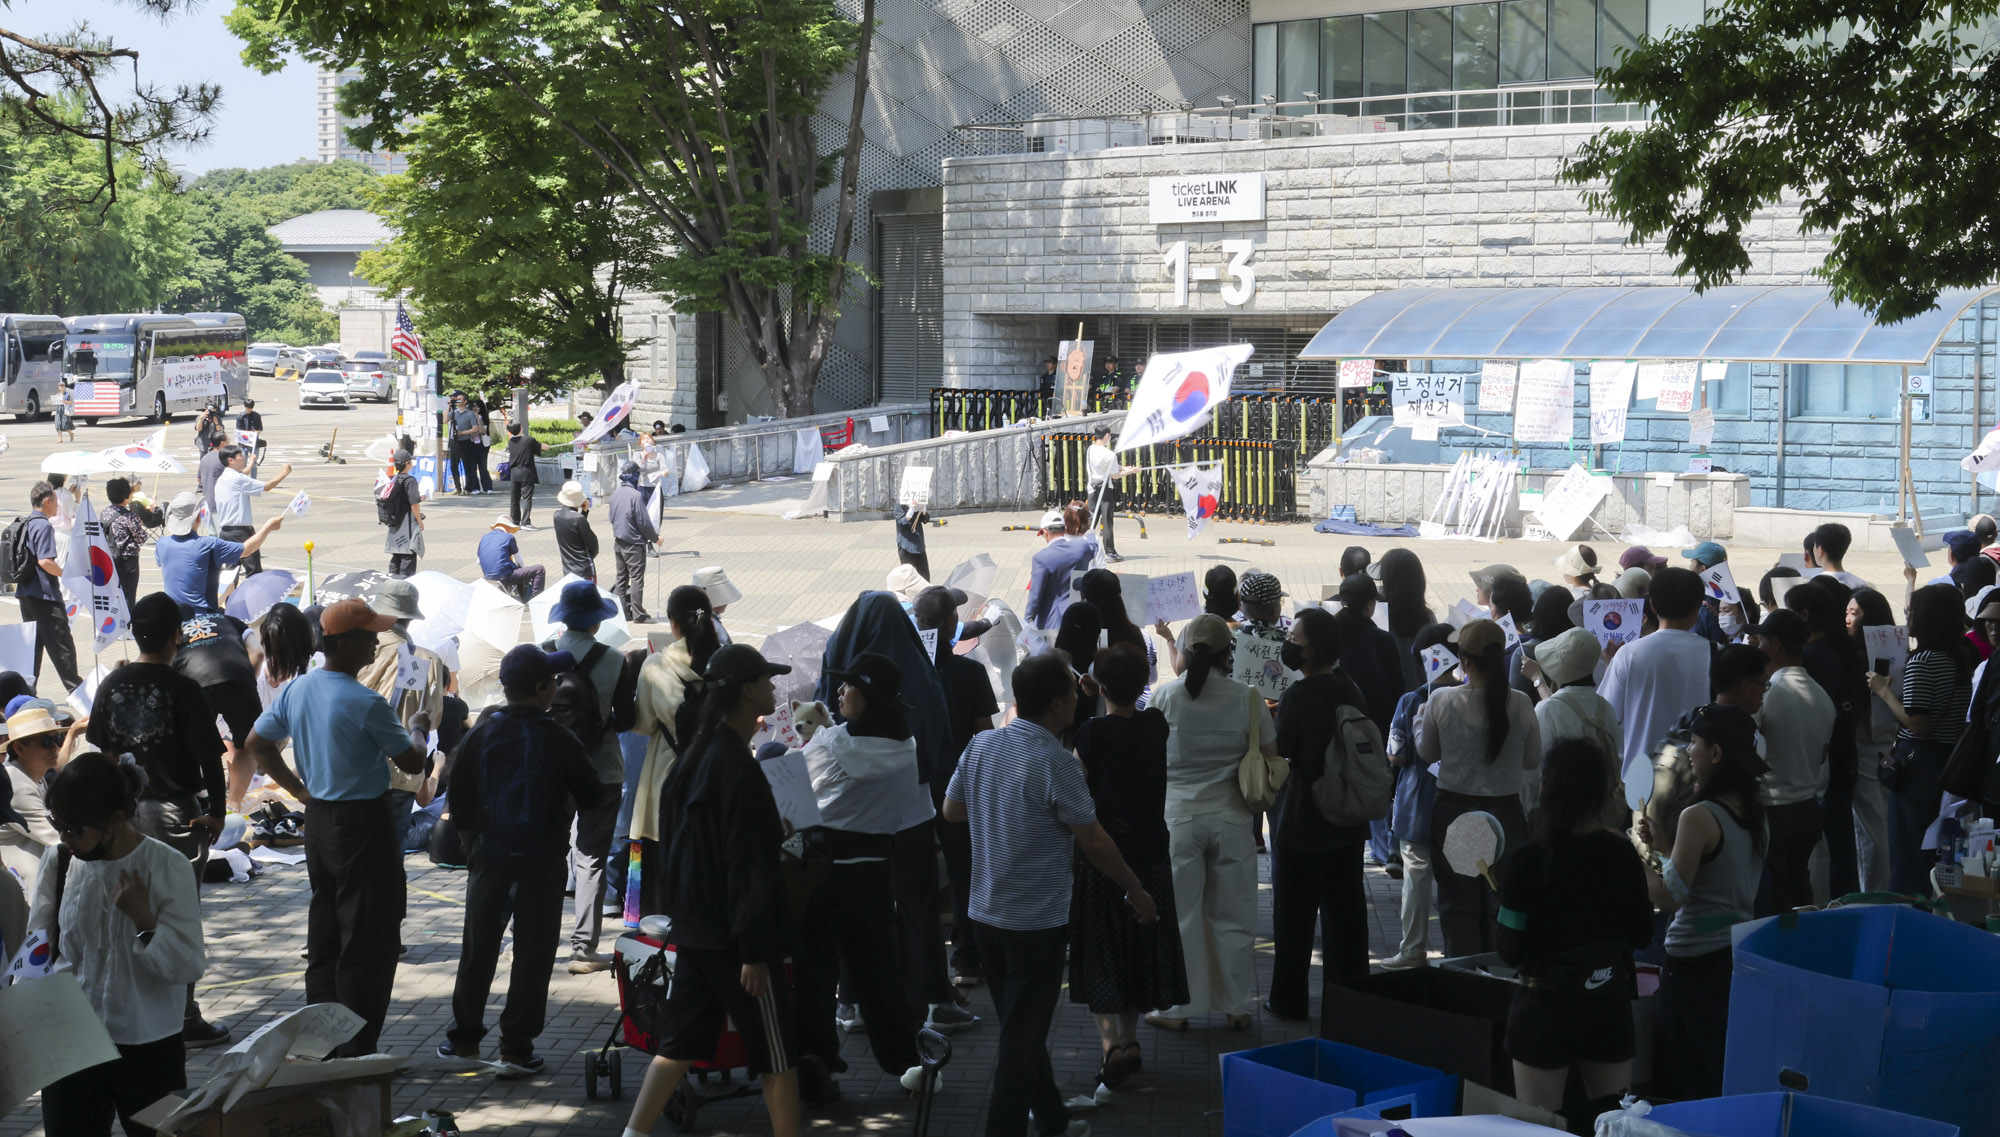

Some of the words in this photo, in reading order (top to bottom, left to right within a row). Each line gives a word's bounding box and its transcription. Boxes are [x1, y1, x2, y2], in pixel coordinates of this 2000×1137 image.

[1171, 180, 1237, 196] ticketLINK
[1178, 197, 1198, 207] LIVE
[1199, 196, 1230, 206] ARENA
[1163, 239, 1256, 306] 1-3
[1396, 376, 1463, 398] 부정선거
[1408, 398, 1449, 416] 재선거
[902, 490, 928, 503] 수개표
[1591, 967, 1614, 981] NIKE
